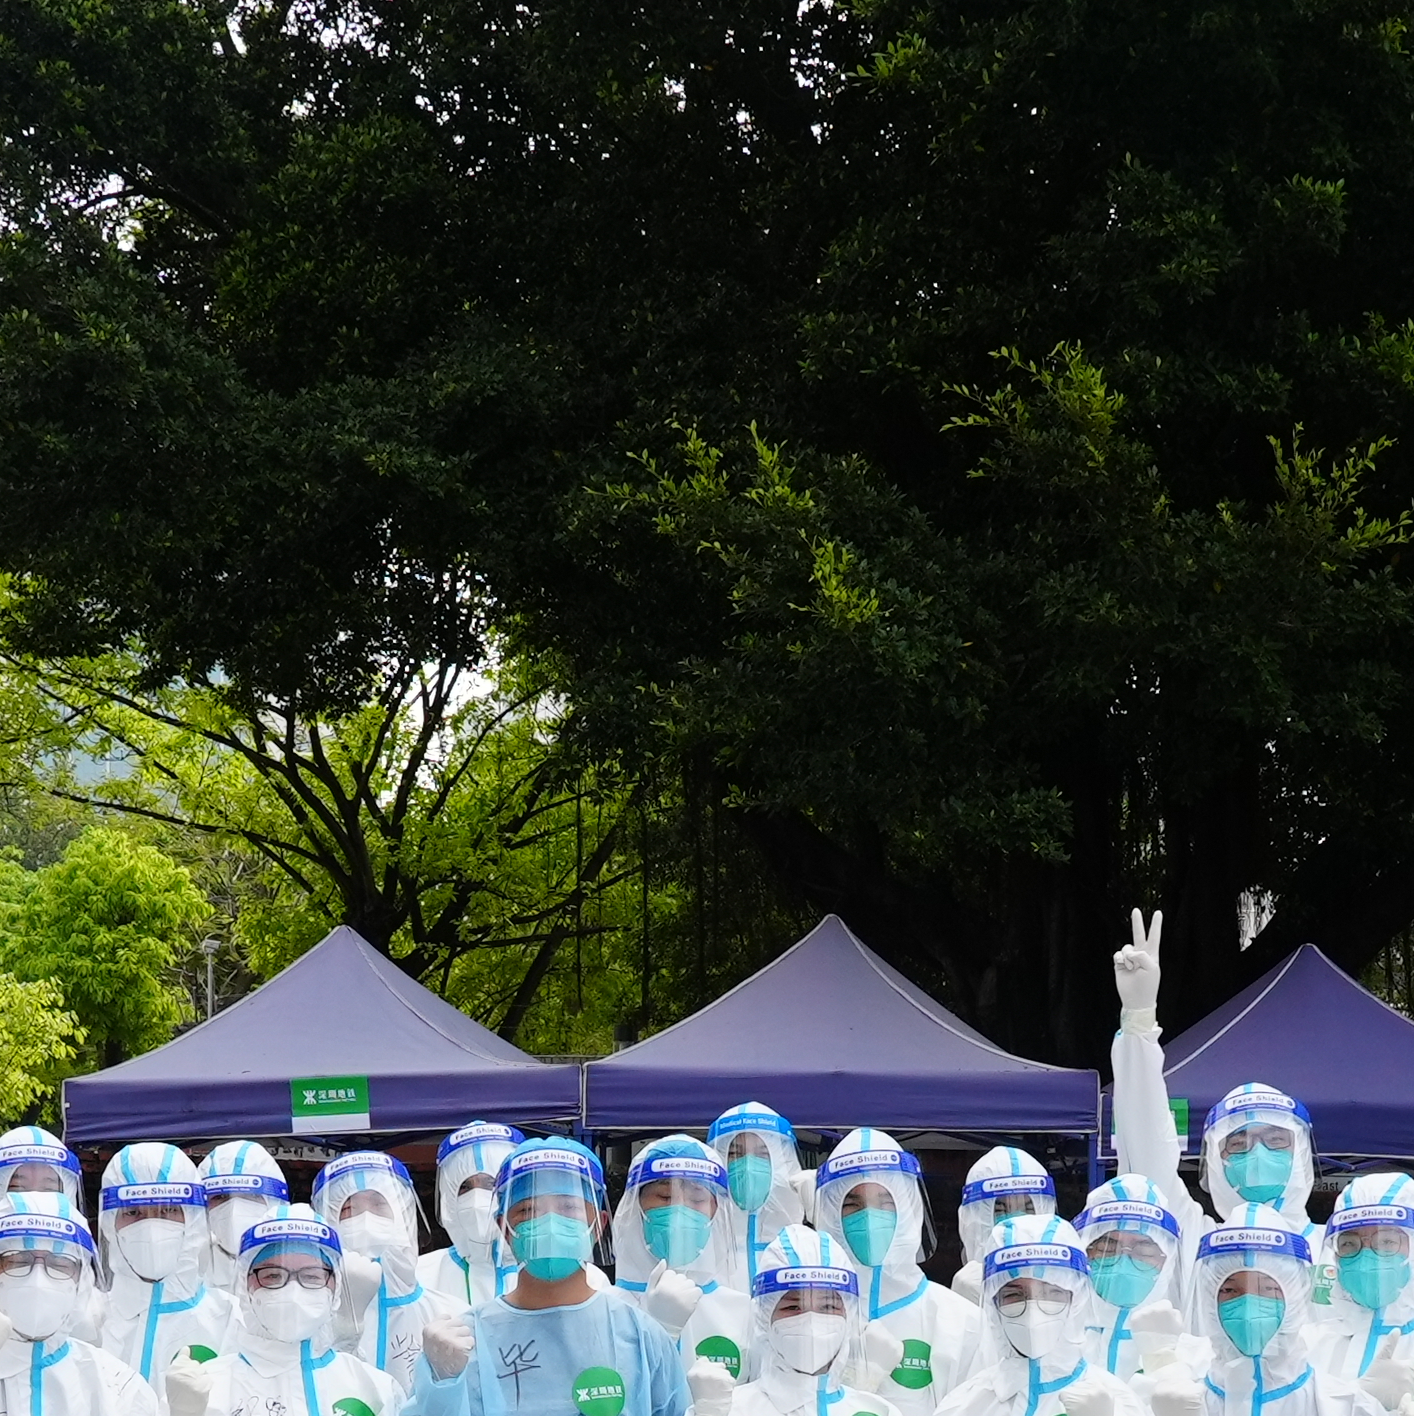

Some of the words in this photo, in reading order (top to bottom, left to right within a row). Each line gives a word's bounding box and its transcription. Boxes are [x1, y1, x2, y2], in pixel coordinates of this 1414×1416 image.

[318, 1088, 356, 1099] 深圳地铁
[1232, 1095, 1253, 1105] Face
[1255, 1094, 1284, 1104] Shield
[720, 1118, 741, 1129] Medical
[742, 1118, 755, 1127] Face
[756, 1117, 776, 1127] Shield
[455, 1129, 475, 1140] Face
[477, 1125, 502, 1135] Shield
[2, 1149, 24, 1158] Face
[26, 1147, 56, 1157] Shield
[518, 1153, 540, 1163] Face
[542, 1152, 576, 1163] Shield
[330, 1159, 348, 1171] Face
[350, 1156, 381, 1165] Shield
[659, 1160, 681, 1169] Face
[683, 1160, 713, 1173] Shield
[834, 1159, 856, 1169] Face
[858, 1154, 888, 1165] Shield
[989, 1180, 1008, 1189] Face
[1011, 1178, 1038, 1188] Shield
[126, 1188, 147, 1198] Face
[149, 1186, 182, 1197] Shield
[1098, 1205, 1119, 1214] Face
[1121, 1204, 1152, 1215] Shield
[1338, 1211, 1358, 1222] Face
[1361, 1207, 1393, 1218] Shield
[0, 1218, 24, 1229] Face
[27, 1218, 62, 1229] Shield
[261, 1225, 283, 1234] Face
[287, 1223, 319, 1234] Shield
[1215, 1233, 1234, 1243] Face
[1237, 1232, 1271, 1242] Shield
[1000, 1250, 1023, 1260] Face
[1025, 1248, 1059, 1258] Shield
[784, 1272, 807, 1281] Face
[809, 1271, 840, 1281] Shield
